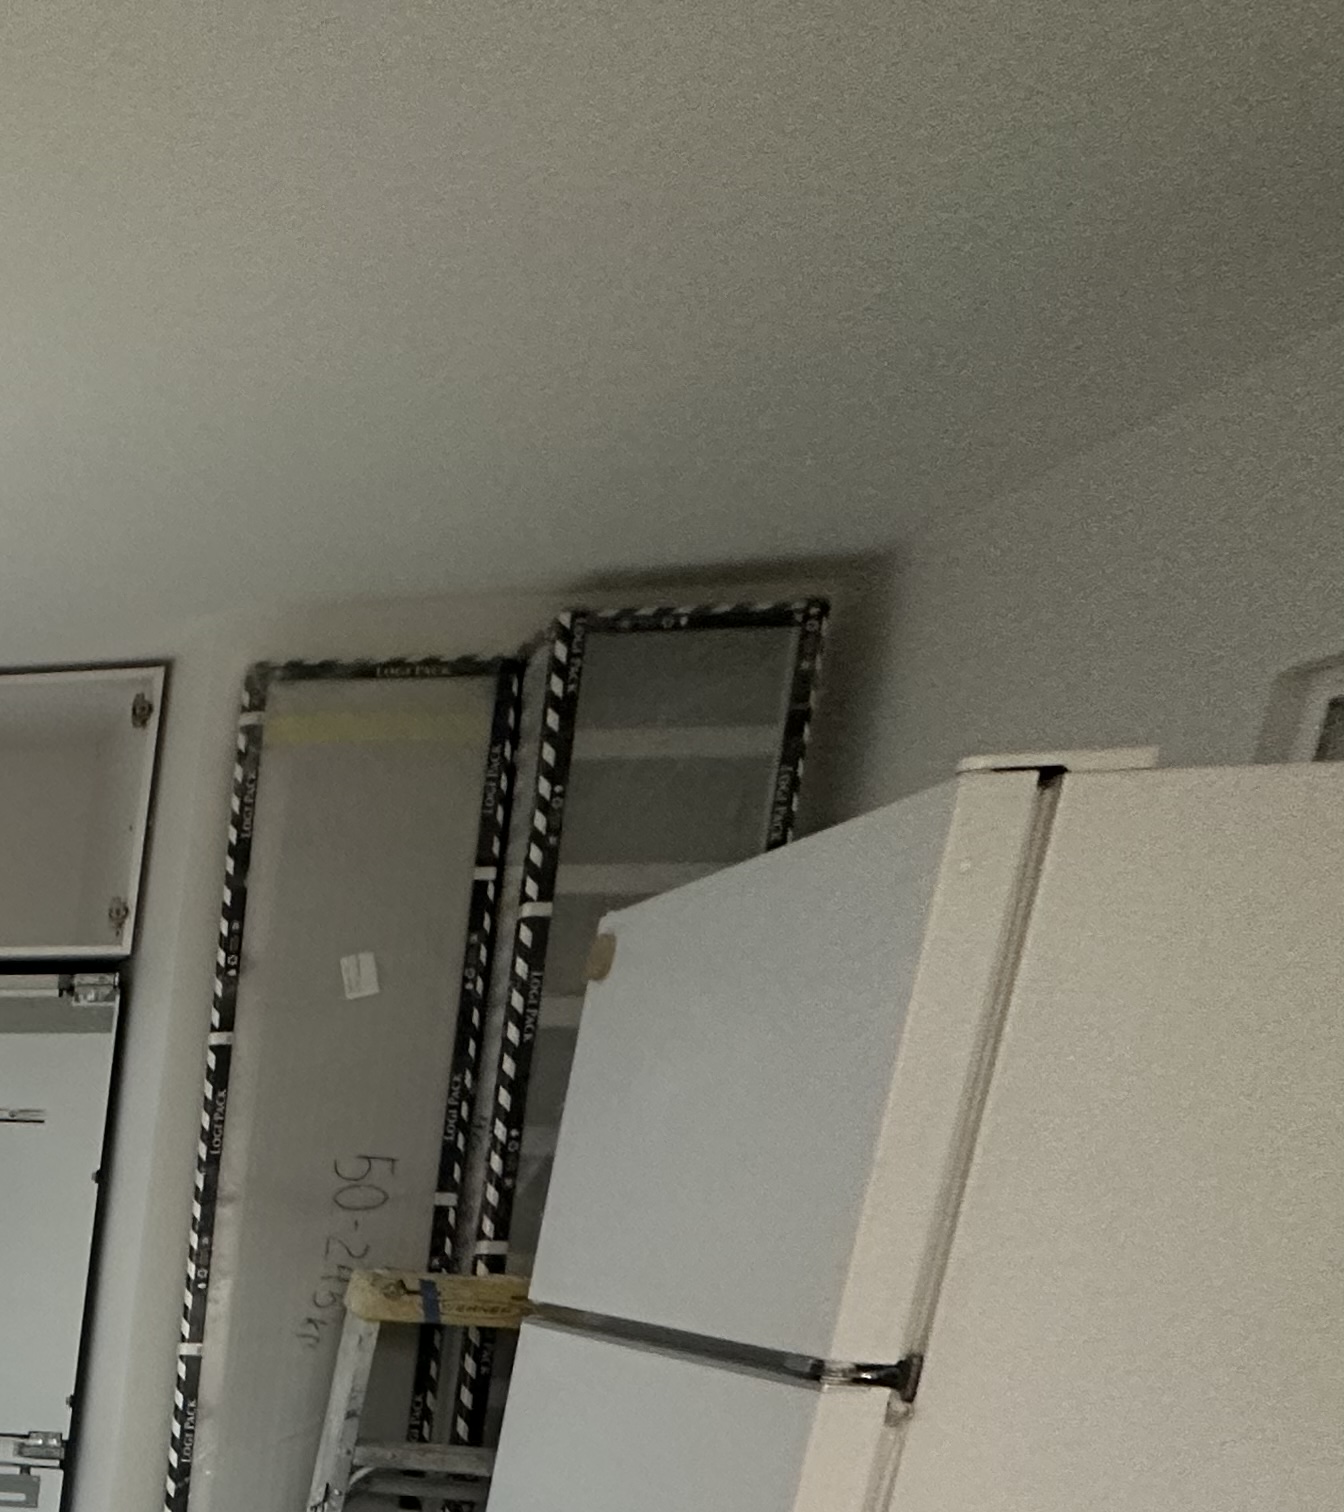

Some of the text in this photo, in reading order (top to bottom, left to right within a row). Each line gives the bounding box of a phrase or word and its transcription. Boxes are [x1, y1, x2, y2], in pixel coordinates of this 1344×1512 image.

[523, 971, 543, 1042] LOGI PACK
[210, 1088, 226, 1155] LOGI PACK
[444, 1074, 463, 1141] LOGI PACK
[181, 1399, 197, 1463] LOGI PACK
